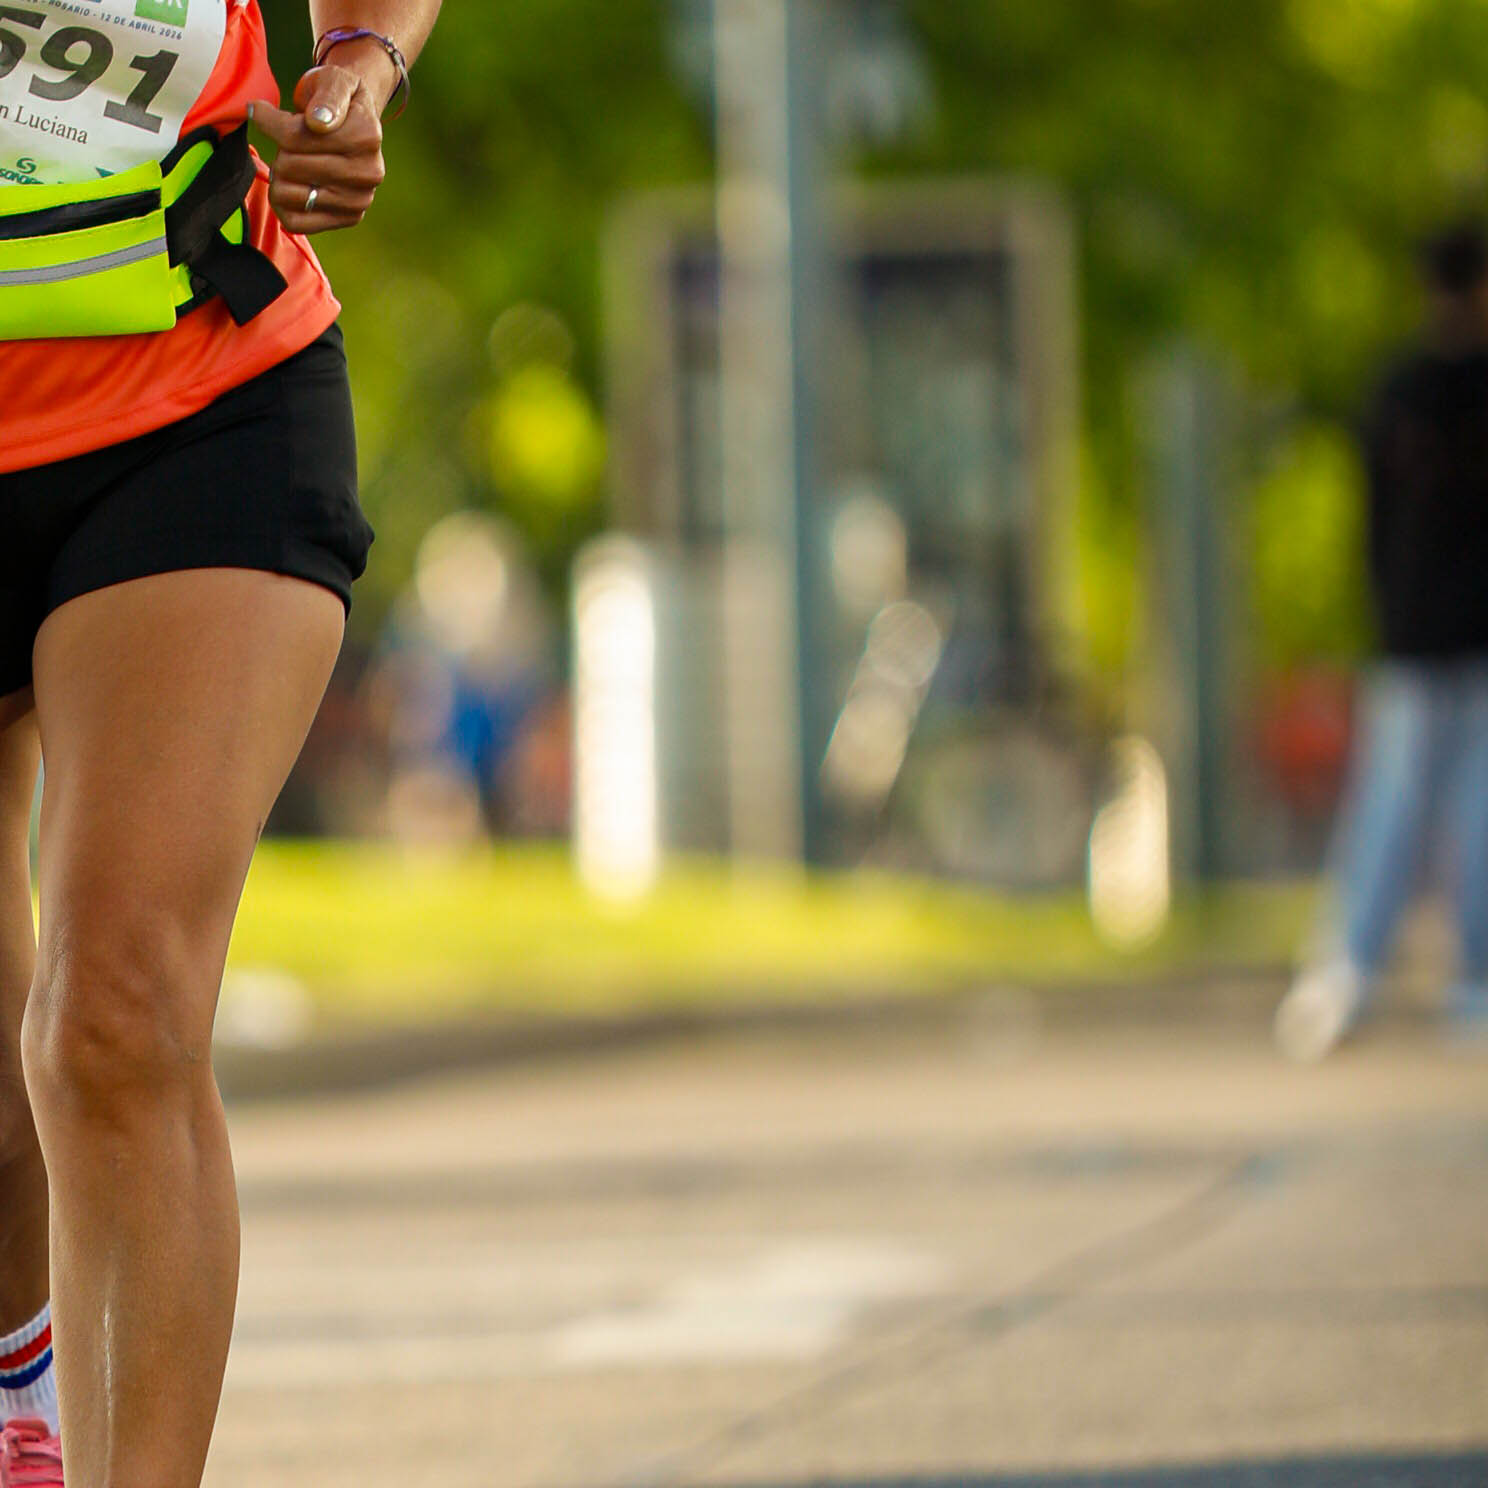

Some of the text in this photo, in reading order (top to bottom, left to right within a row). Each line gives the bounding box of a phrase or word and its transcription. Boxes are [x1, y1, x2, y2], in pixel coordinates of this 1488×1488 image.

[101, 12, 111, 22] 12
[114, 16, 126, 26] DE
[129, 20, 156, 34] ABRIL
[159, 27, 183, 41] 2026
[14, 105, 89, 145] Luciana
